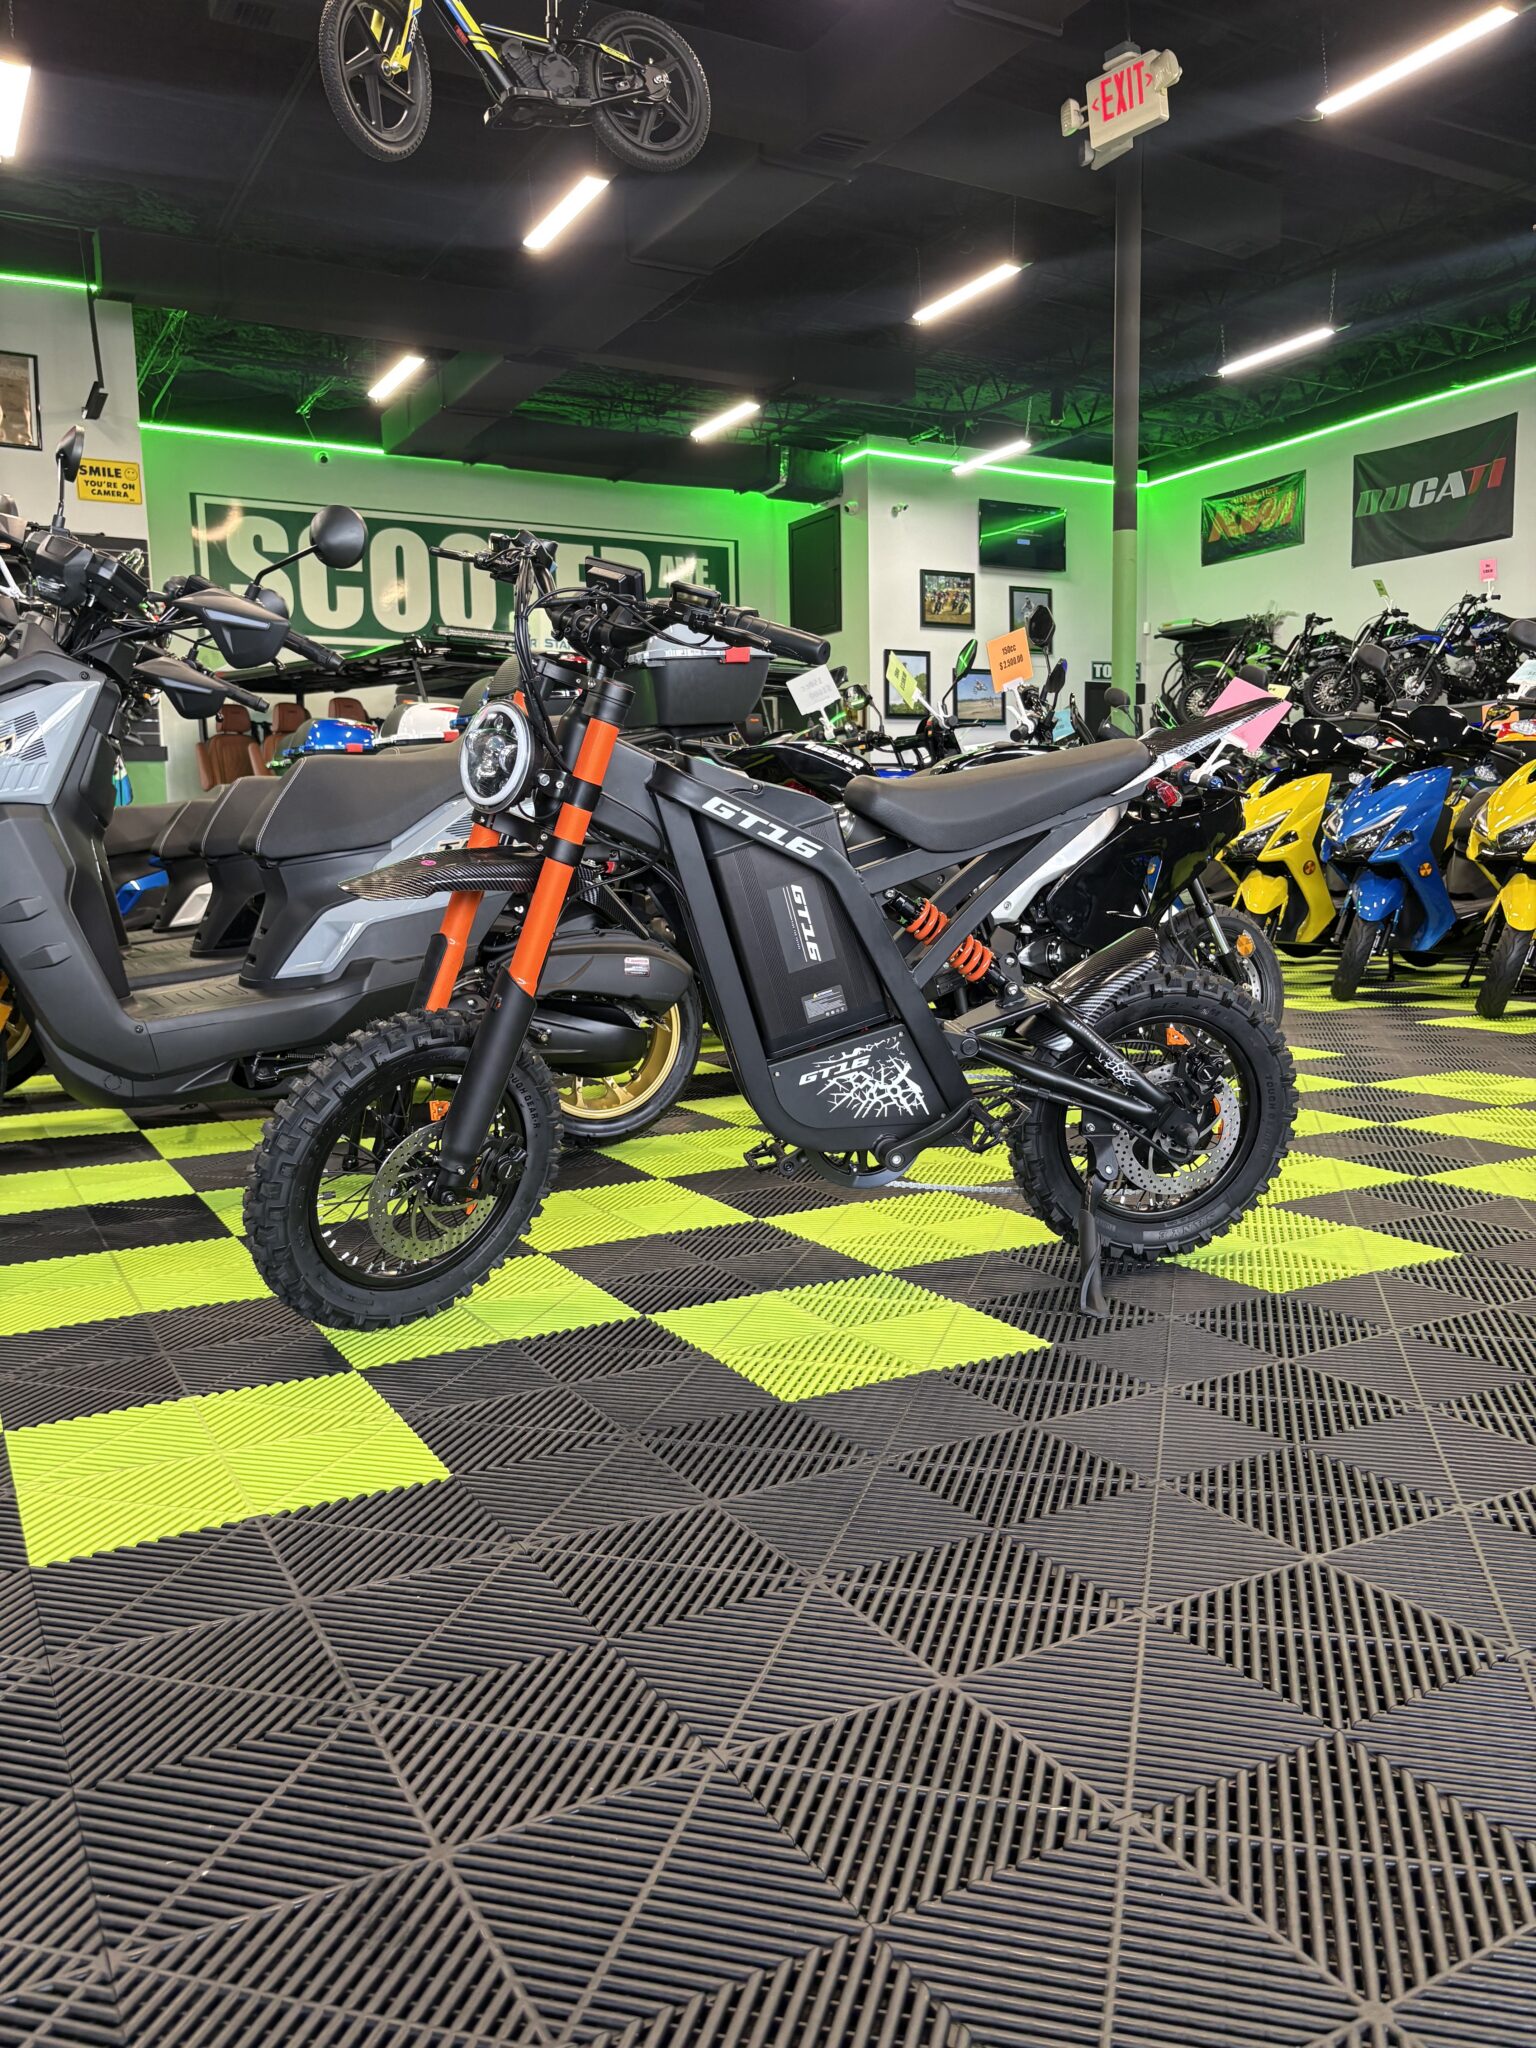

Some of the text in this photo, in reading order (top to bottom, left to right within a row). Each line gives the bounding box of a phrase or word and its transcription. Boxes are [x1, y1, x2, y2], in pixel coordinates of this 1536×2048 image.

[1100, 60, 1145, 123] EXIT
[79, 465, 123, 478] SMILE
[84, 480, 118, 489] YOU'RE
[91, 489, 129, 498] CAMERA
[1355, 457, 1507, 518] DUCATI
[226, 515, 653, 645] SCOO
[701, 795, 825, 860] GT16
[790, 883, 822, 963] GT16
[798, 1054, 872, 1086] GT16
